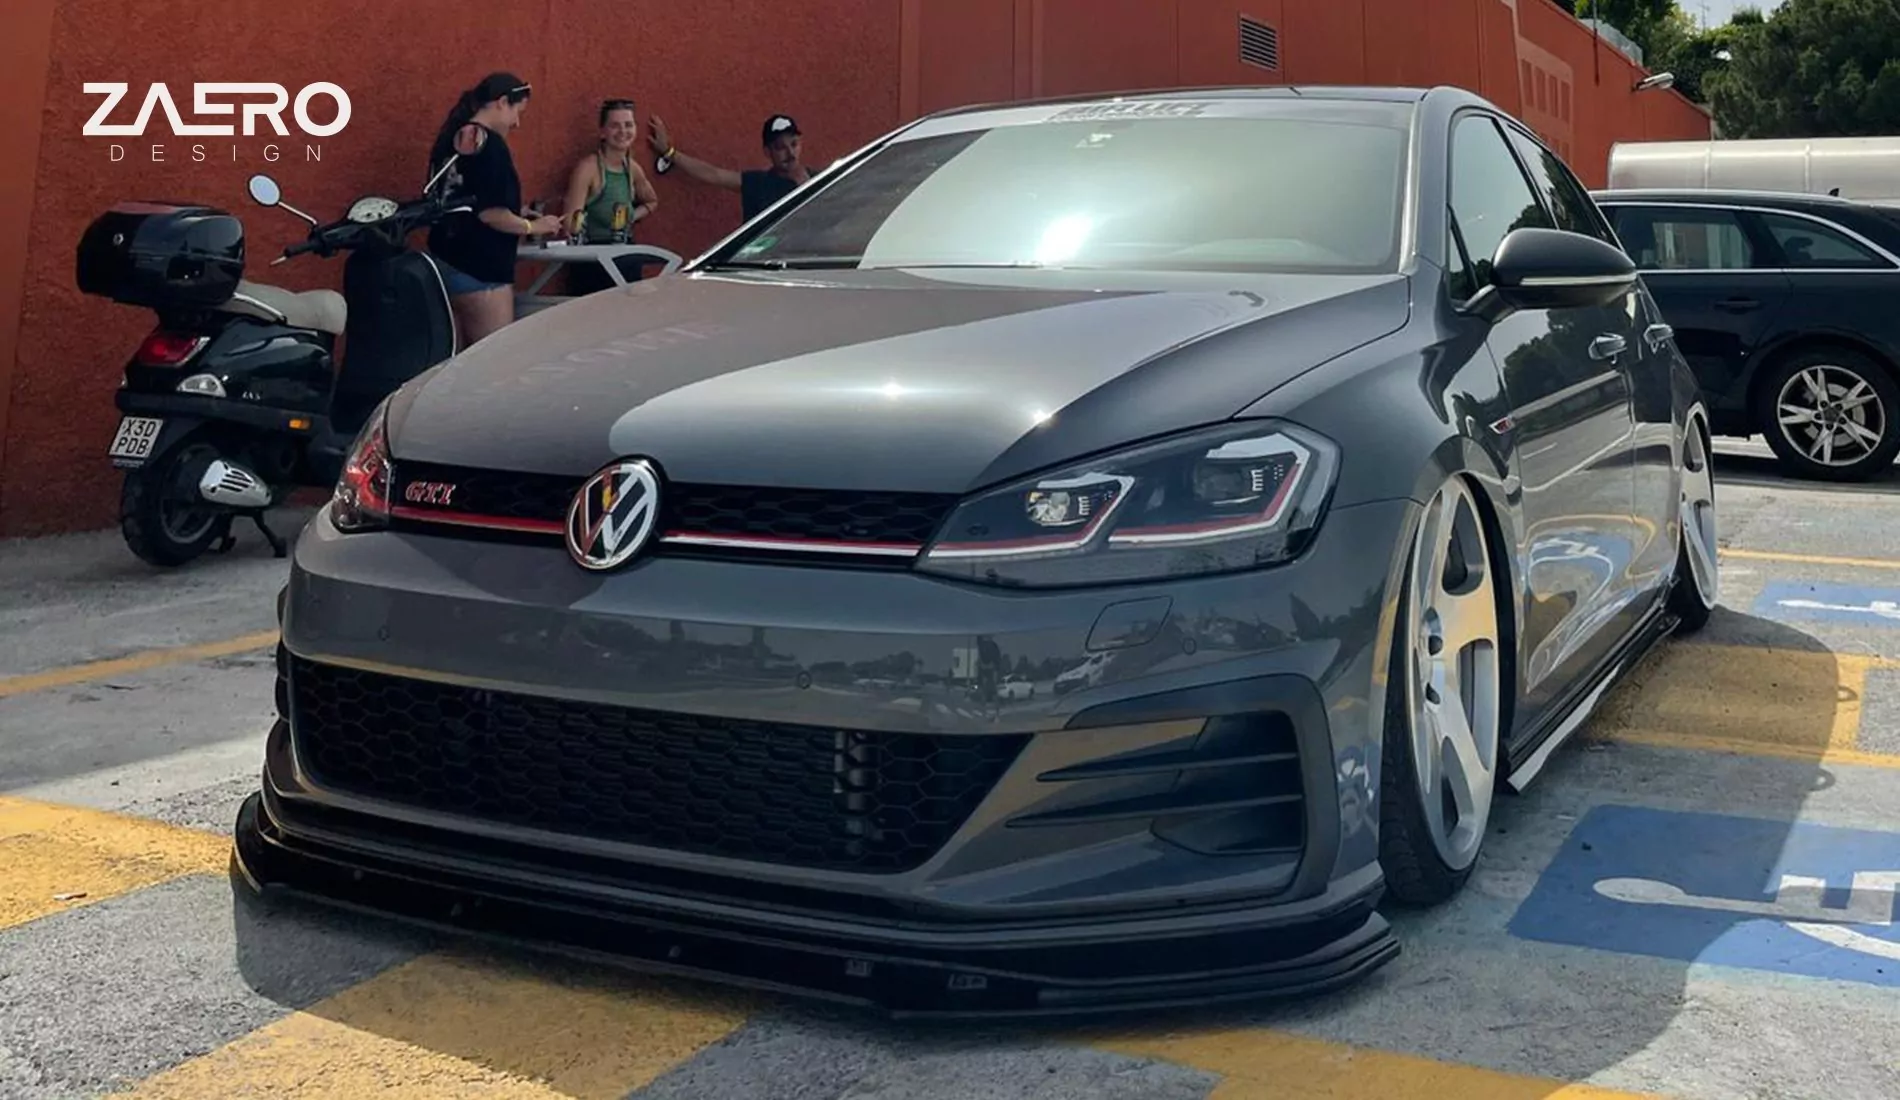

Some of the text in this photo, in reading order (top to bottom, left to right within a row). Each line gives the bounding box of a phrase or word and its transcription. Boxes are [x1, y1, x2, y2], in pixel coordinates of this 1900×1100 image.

[122, 418, 157, 438] X3D
[115, 436, 150, 456] PDB
[404, 480, 457, 505] GTI
